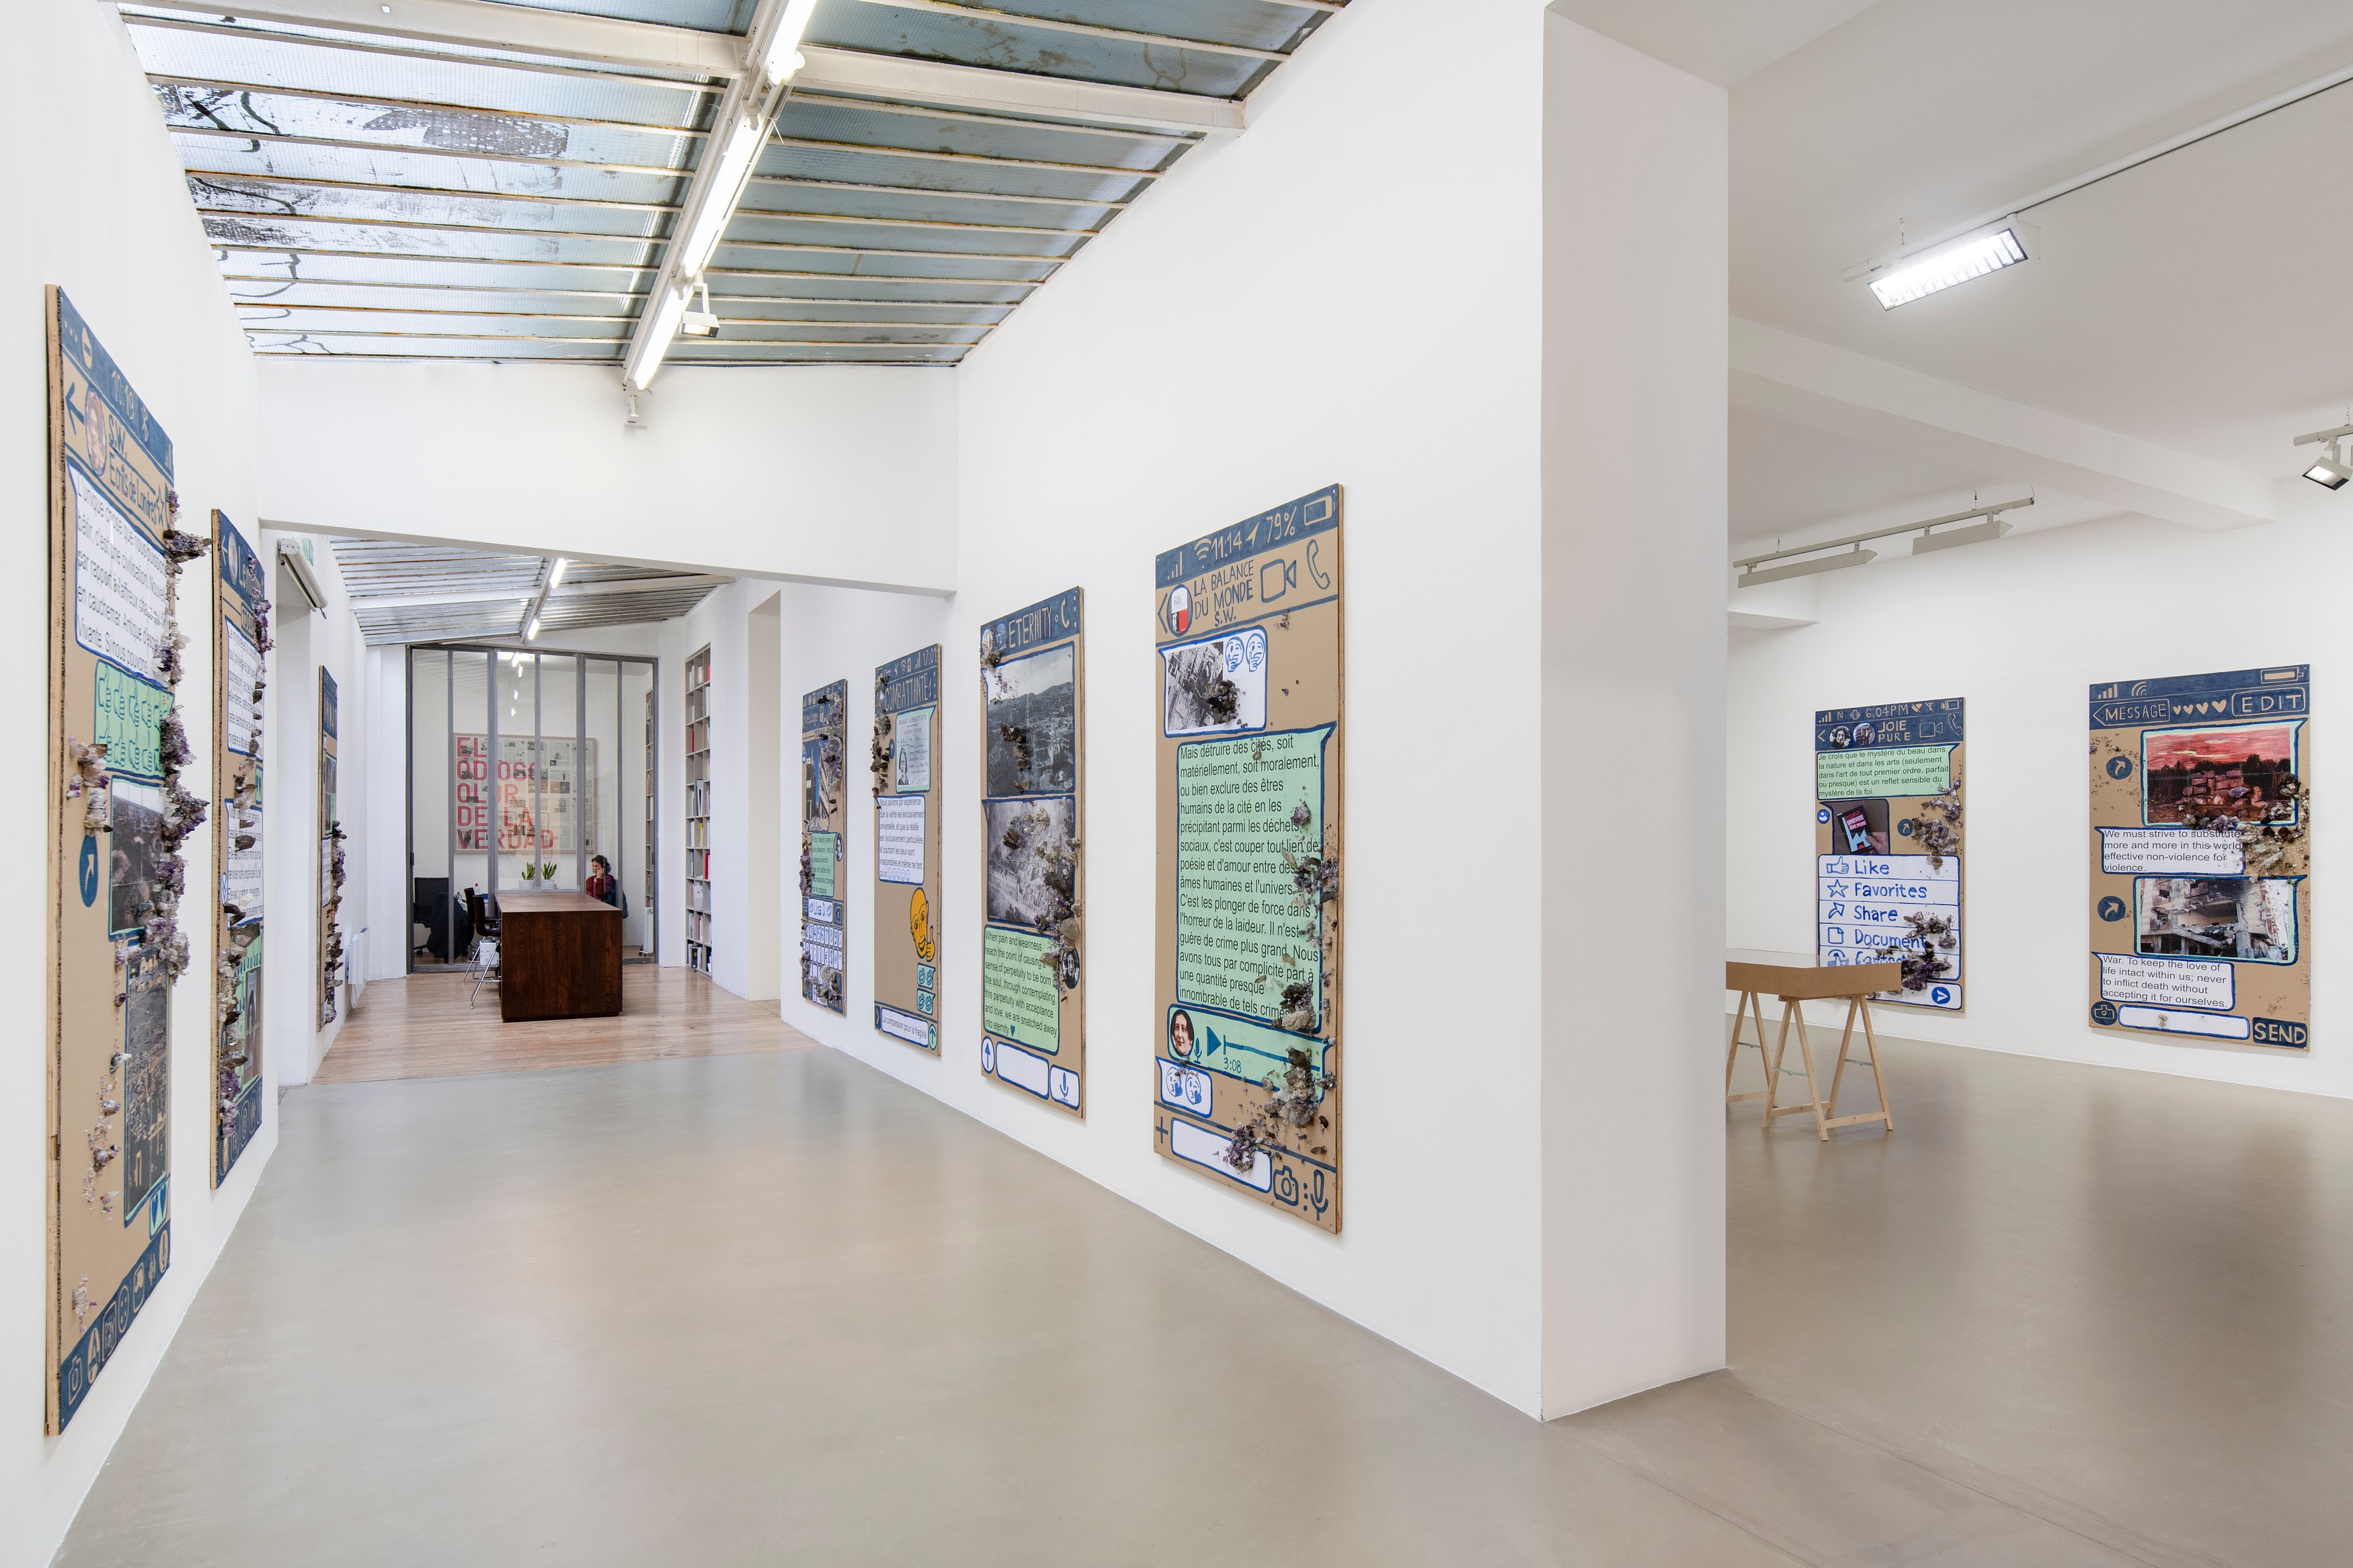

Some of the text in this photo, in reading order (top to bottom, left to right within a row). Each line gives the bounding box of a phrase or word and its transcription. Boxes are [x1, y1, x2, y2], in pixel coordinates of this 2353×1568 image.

[112, 370, 134, 420] 10:19
[108, 414, 128, 460] S.W.
[128, 472, 136, 504] de
[136, 478, 157, 526] Londres
[1211, 506, 1297, 561] 11:14 79%
[1195, 559, 1254, 597] LA BALANCE
[1195, 579, 1254, 620] DU MONDE
[1215, 606, 1236, 628] S.W.
[1008, 606, 1053, 649] ETERNITY
[885, 673, 928, 712] COMBATTANTE
[2241, 694, 2302, 712] EDIT
[2105, 704, 2167, 721] MESSAGE
[1878, 720, 1907, 733] JOIE
[1878, 732, 1911, 743] PURE
[456, 737, 487, 757] EL
[1181, 734, 1293, 759] Mais détruire des cités, soit
[1867, 750, 1894, 758] mystère
[1181, 754, 1318, 777] matériellement, soit moralement,
[1902, 757, 1942, 766] (seulement
[1925, 766, 1948, 774] parfait
[456, 760, 540, 782] ODOS
[1180, 778, 1283, 796] ou bien exclure des êtres
[1829, 780, 1857, 788] presque)
[1818, 790, 1844, 798] mystère
[1181, 798, 1281, 814] humains de la cité en les
[457, 806, 533, 827] DE LA
[1181, 820, 1220, 835] précipitant
[1222, 819, 1245, 835] parmi
[1248, 819, 1261, 832] les
[2149, 829, 2175, 837] strive
[2178, 829, 2188, 837] to
[2191, 829, 2240, 837] substitute
[1180, 839, 1318, 855] sociaux, c'est couper tout lien de
[2180, 841, 2189, 849] in
[2213, 841, 2242, 850] world
[2104, 852, 2227, 861] effective non-violence for
[1180, 857, 1294, 874] poésie et d'amour entre des
[1854, 860, 1890, 875] Like
[1854, 882, 1927, 899] Favorites
[813, 901, 822, 916] Lisa
[1854, 905, 1898, 922] Share
[1855, 929, 1926, 948] Document
[2103, 955, 2221, 971] War. To keep the love of
[1180, 971, 1264, 995] une quantité presque
[2103, 966, 2116, 975] life
[2119, 968, 2144, 977] intact
[2147, 971, 2175, 979] within
[2197, 975, 2226, 983] never
[2114, 979, 2138, 987] inflict
[2141, 981, 2168, 990] death
[2171, 984, 2207, 993] without
[993, 993, 1014, 1007] perpetuity
[1015, 999, 1025, 1009] with
[1025, 1003, 1053, 1018] acceptance
[2103, 990, 2227, 1007] accepting it for ourselves.
[985, 1005, 1057, 1038] and love, we are snatched away
[2254, 1022, 2307, 1044] SEND
[1224, 1057, 1242, 1073] 3:08
